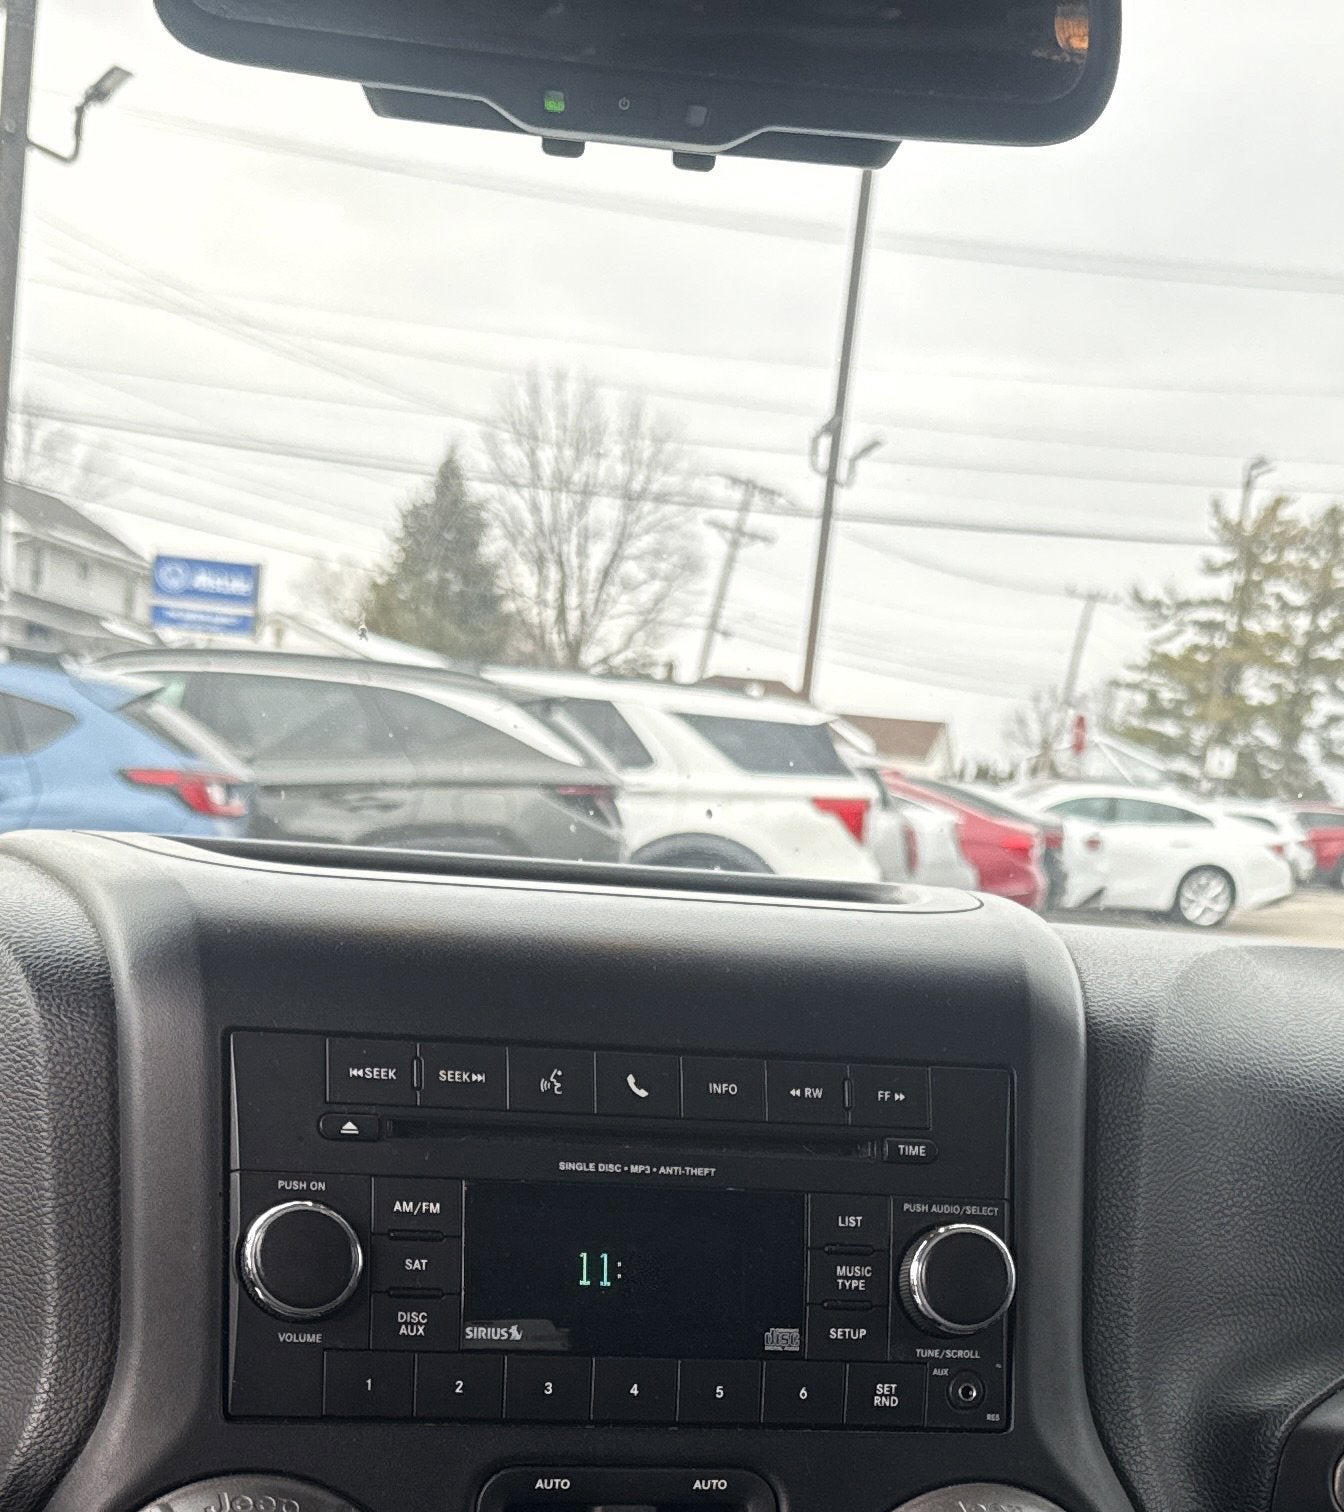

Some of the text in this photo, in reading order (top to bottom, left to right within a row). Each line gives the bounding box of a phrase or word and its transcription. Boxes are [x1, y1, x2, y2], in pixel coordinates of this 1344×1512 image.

[365, 1068, 397, 1080] SEEK
[439, 1070, 471, 1082] SEEK
[708, 1083, 738, 1095] INFO
[804, 1087, 823, 1099] RW
[877, 1091, 891, 1102] FF
[898, 1145, 926, 1157] TIME
[559, 1162, 716, 1177] SINGLE DISC MP3 ANTI-THEFT
[278, 1180, 326, 1191] PUSH ON
[393, 1201, 441, 1215] AM/FM
[903, 1203, 999, 1217] PUSH AUDIO/SELECT
[838, 1216, 862, 1228] LIST
[405, 1259, 427, 1271] SAT
[836, 1265, 872, 1278] MUSIC
[836, 1279, 866, 1291] TYPE
[397, 1311, 428, 1324] DISC
[399, 1325, 425, 1337] AUX
[465, 1326, 508, 1340] SIRIUS
[829, 1328, 867, 1340] SETUP
[278, 1332, 322, 1344] VOLUME
[915, 1348, 981, 1360] TUNE/SCROLL
[932, 1368, 949, 1377] AUX
[366, 1379, 372, 1391] 1
[455, 1380, 463, 1394] 2
[544, 1382, 553, 1395] 3
[630, 1384, 639, 1397] 4
[875, 1384, 898, 1395] SET
[716, 1386, 724, 1399] 5
[799, 1387, 808, 1400] 6
[873, 1396, 899, 1407] RND
[535, 1479, 570, 1490] AUTO
[692, 1479, 727, 1491] AUTO
